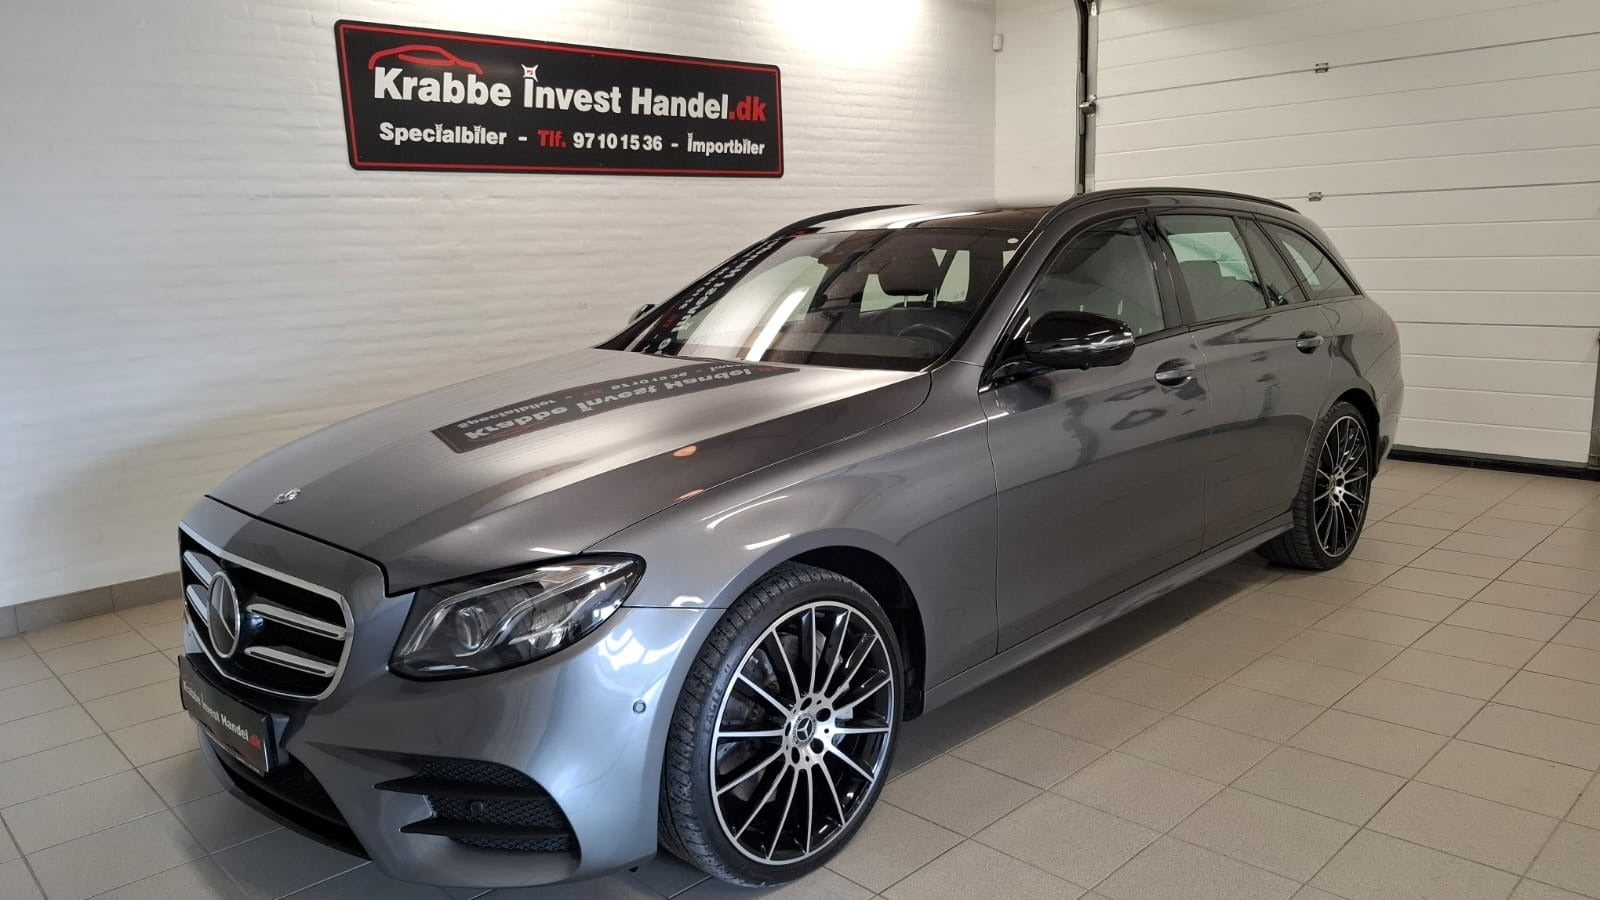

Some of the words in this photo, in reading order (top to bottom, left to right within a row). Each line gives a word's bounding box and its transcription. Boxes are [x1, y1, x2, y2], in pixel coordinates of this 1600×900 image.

[374, 66, 512, 107] Krabbe
[631, 86, 767, 121] Handel.dk
[379, 122, 507, 145] Specialbiler
[537, 129, 567, 147] Tlf.
